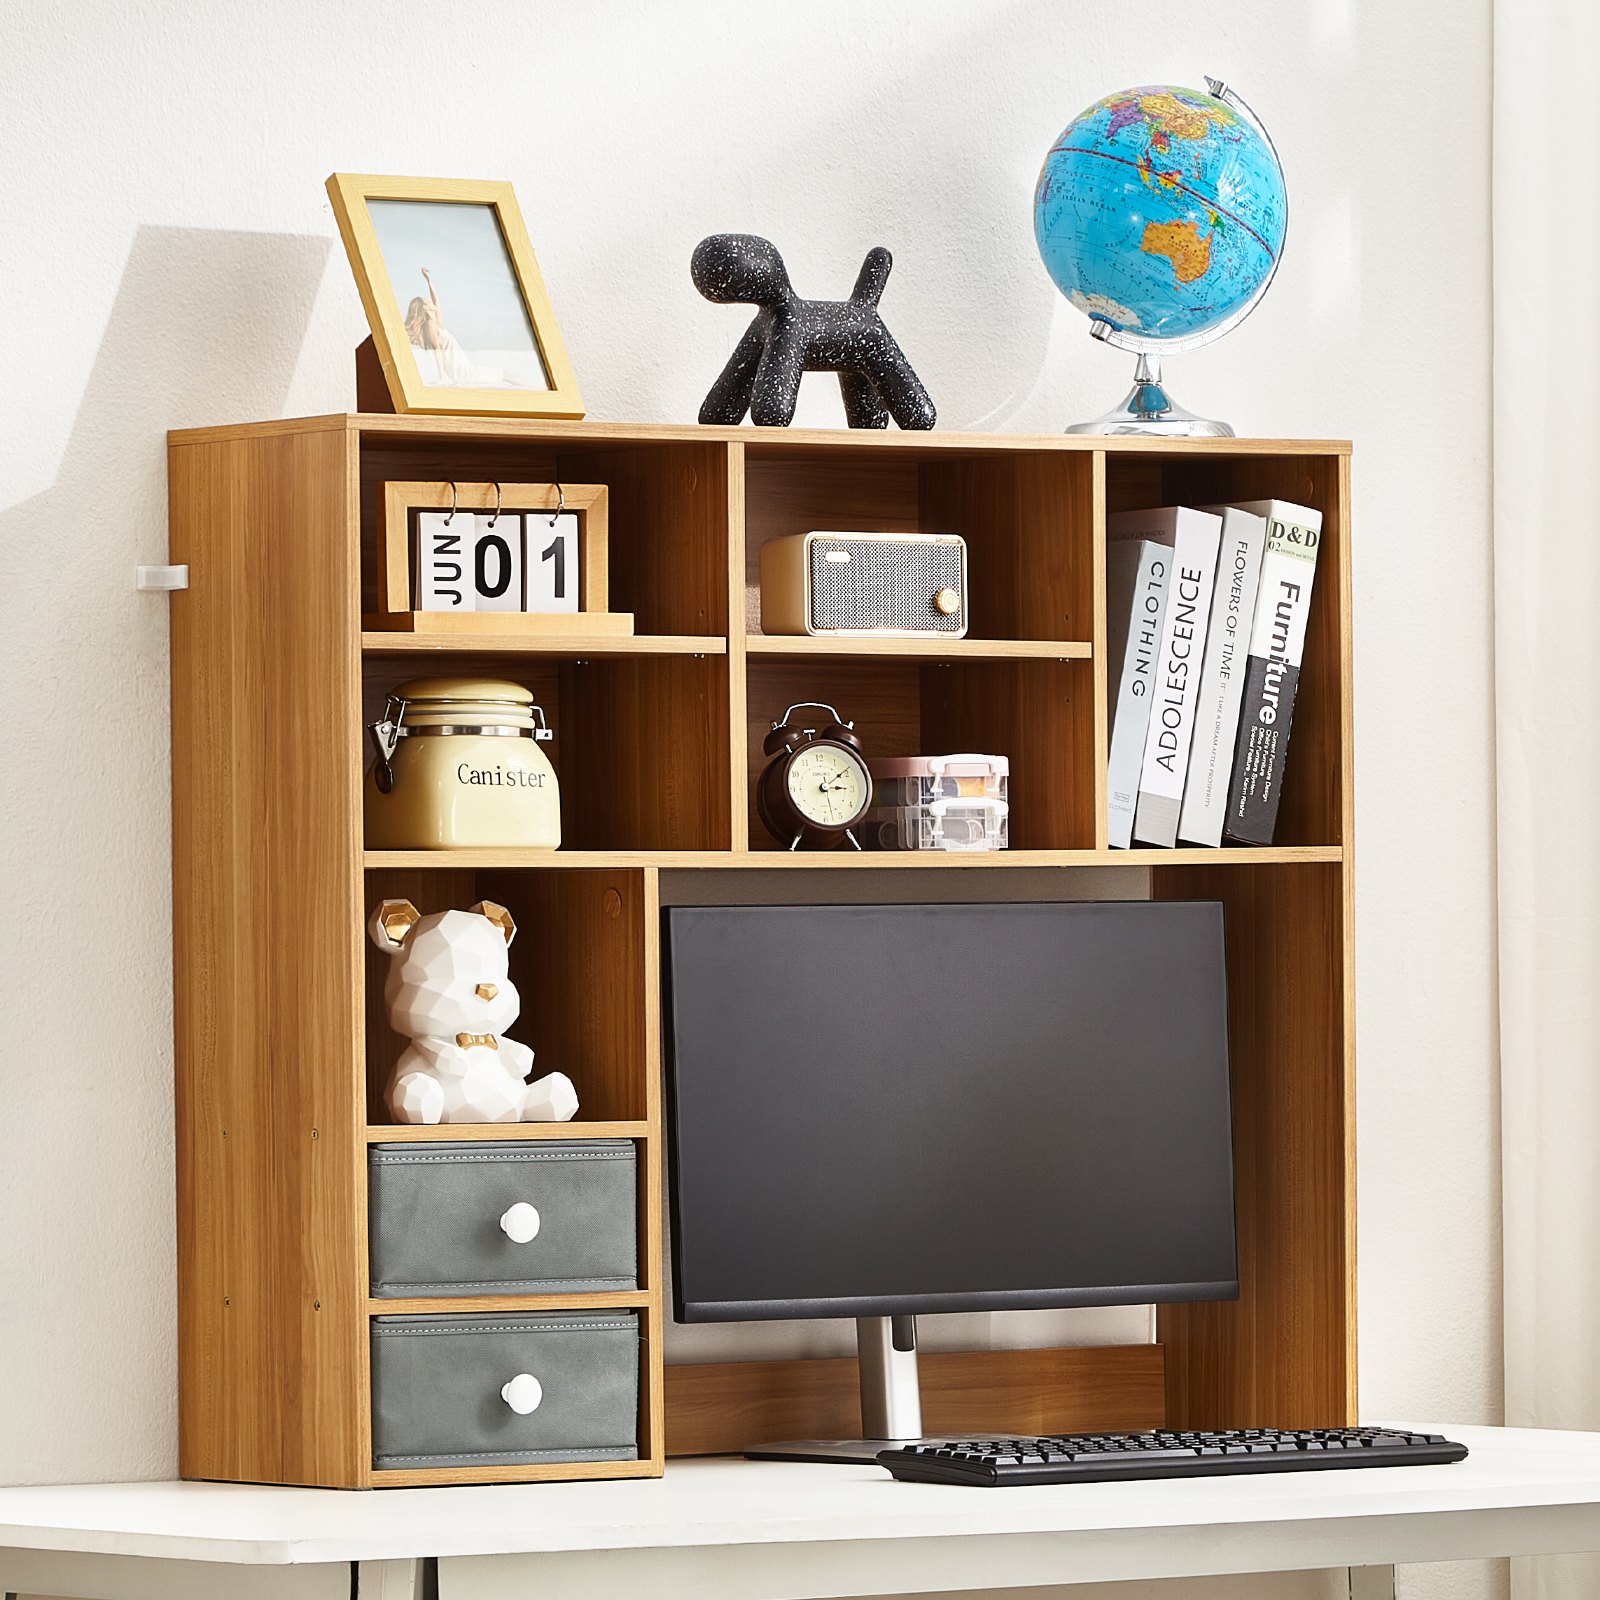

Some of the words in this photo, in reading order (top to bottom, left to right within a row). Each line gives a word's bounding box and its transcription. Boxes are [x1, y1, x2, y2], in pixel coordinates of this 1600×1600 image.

[433, 534, 462, 605] JUN
[1228, 540, 1248, 613] FLOWERS
[1132, 561, 1165, 697] CLOTHING
[1225, 615, 1238, 638] OF
[1219, 642, 1235, 680] TIME
[1259, 580, 1301, 725] Furniture
[1156, 567, 1201, 773] ADOLESCENCE
[1212, 721, 1221, 746] DREAM
[1249, 725, 1258, 748] Special
[1256, 727, 1265, 745] Office
[1264, 729, 1272, 749] Child's
[1270, 731, 1279, 754] Current
[801, 759, 809, 767] 11
[815, 754, 824, 762] 12
[1209, 746, 1217, 768] AFTER
[1245, 748, 1254, 771] Feature
[1252, 745, 1262, 772] Furniture
[1260, 750, 1269, 777] Furniture
[1266, 754, 1276, 781] Furniture
[457, 763, 546, 788] Canister
[791, 770, 800, 778] 10
[1249, 772, 1258, 796] System
[850, 785, 855, 793] 3
[1205, 768, 1214, 808] PROSPERITY
[1242, 777, 1250, 795] Karim
[1262, 781, 1272, 802] Design
[1238, 795, 1247, 817] Rashid
